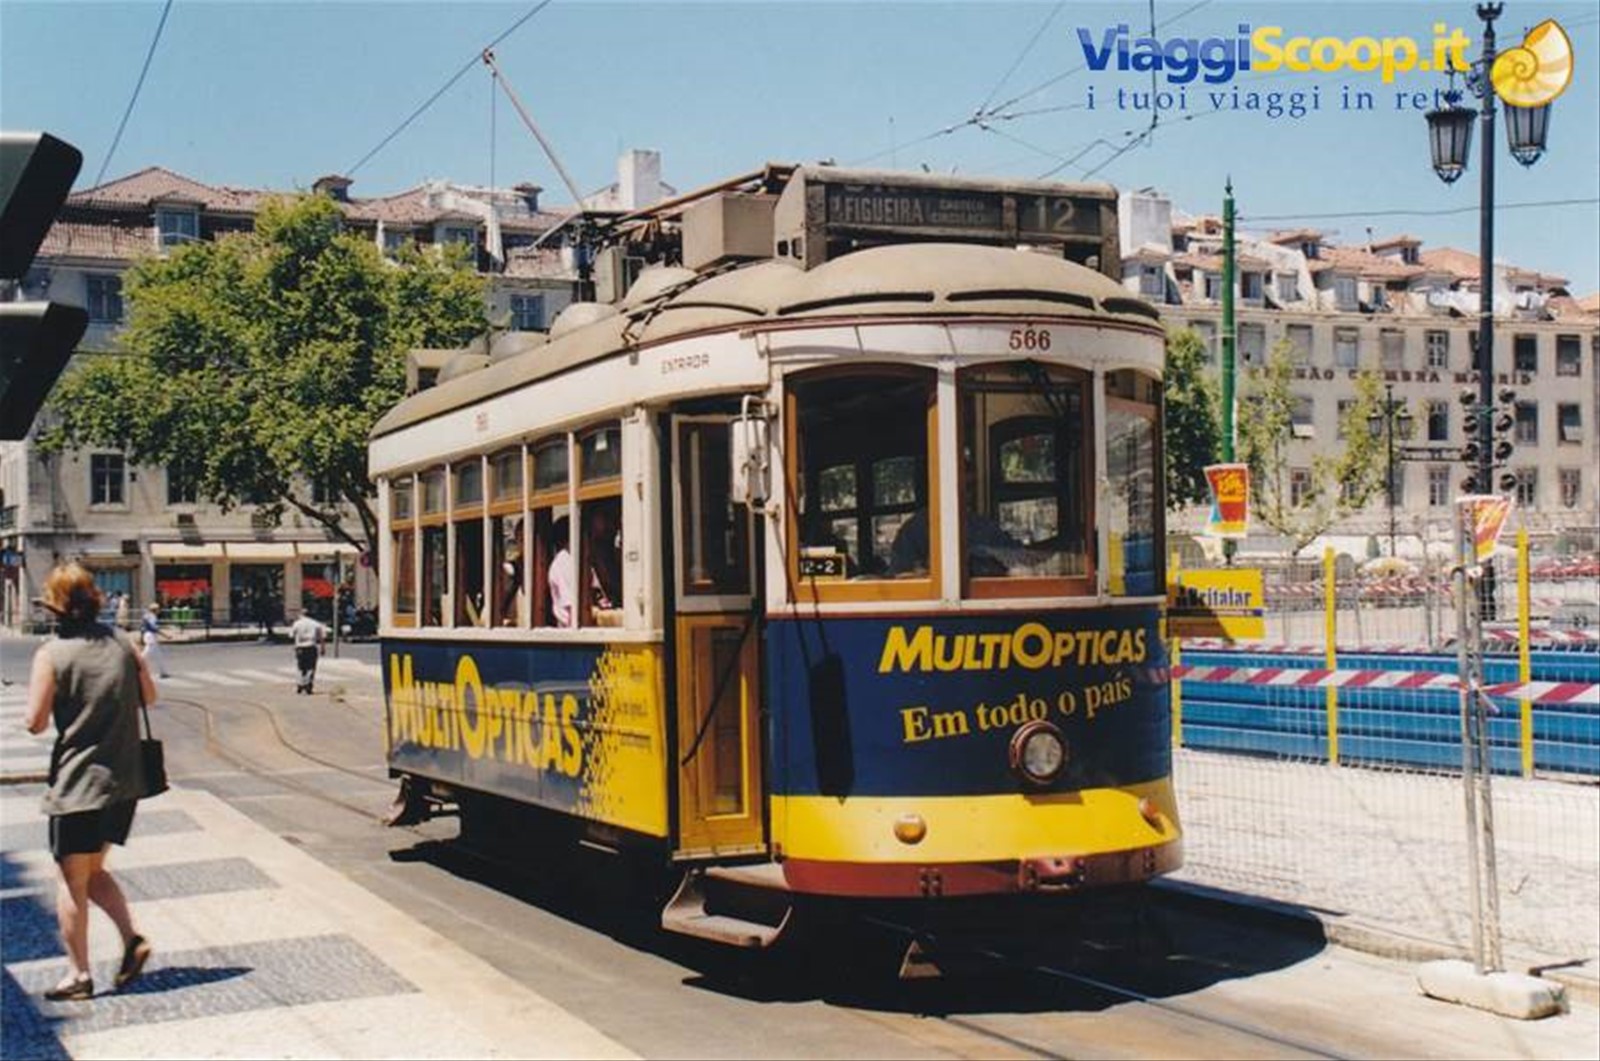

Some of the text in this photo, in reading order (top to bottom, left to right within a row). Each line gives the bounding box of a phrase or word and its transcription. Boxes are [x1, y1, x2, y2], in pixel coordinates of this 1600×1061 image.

[1034, 196, 1076, 231] 12
[1009, 328, 1051, 351] 566
[1347, 368, 1441, 384] CMBRA
[1454, 371, 1533, 386] MARID
[900, 672, 1133, 744] Em todo o país
